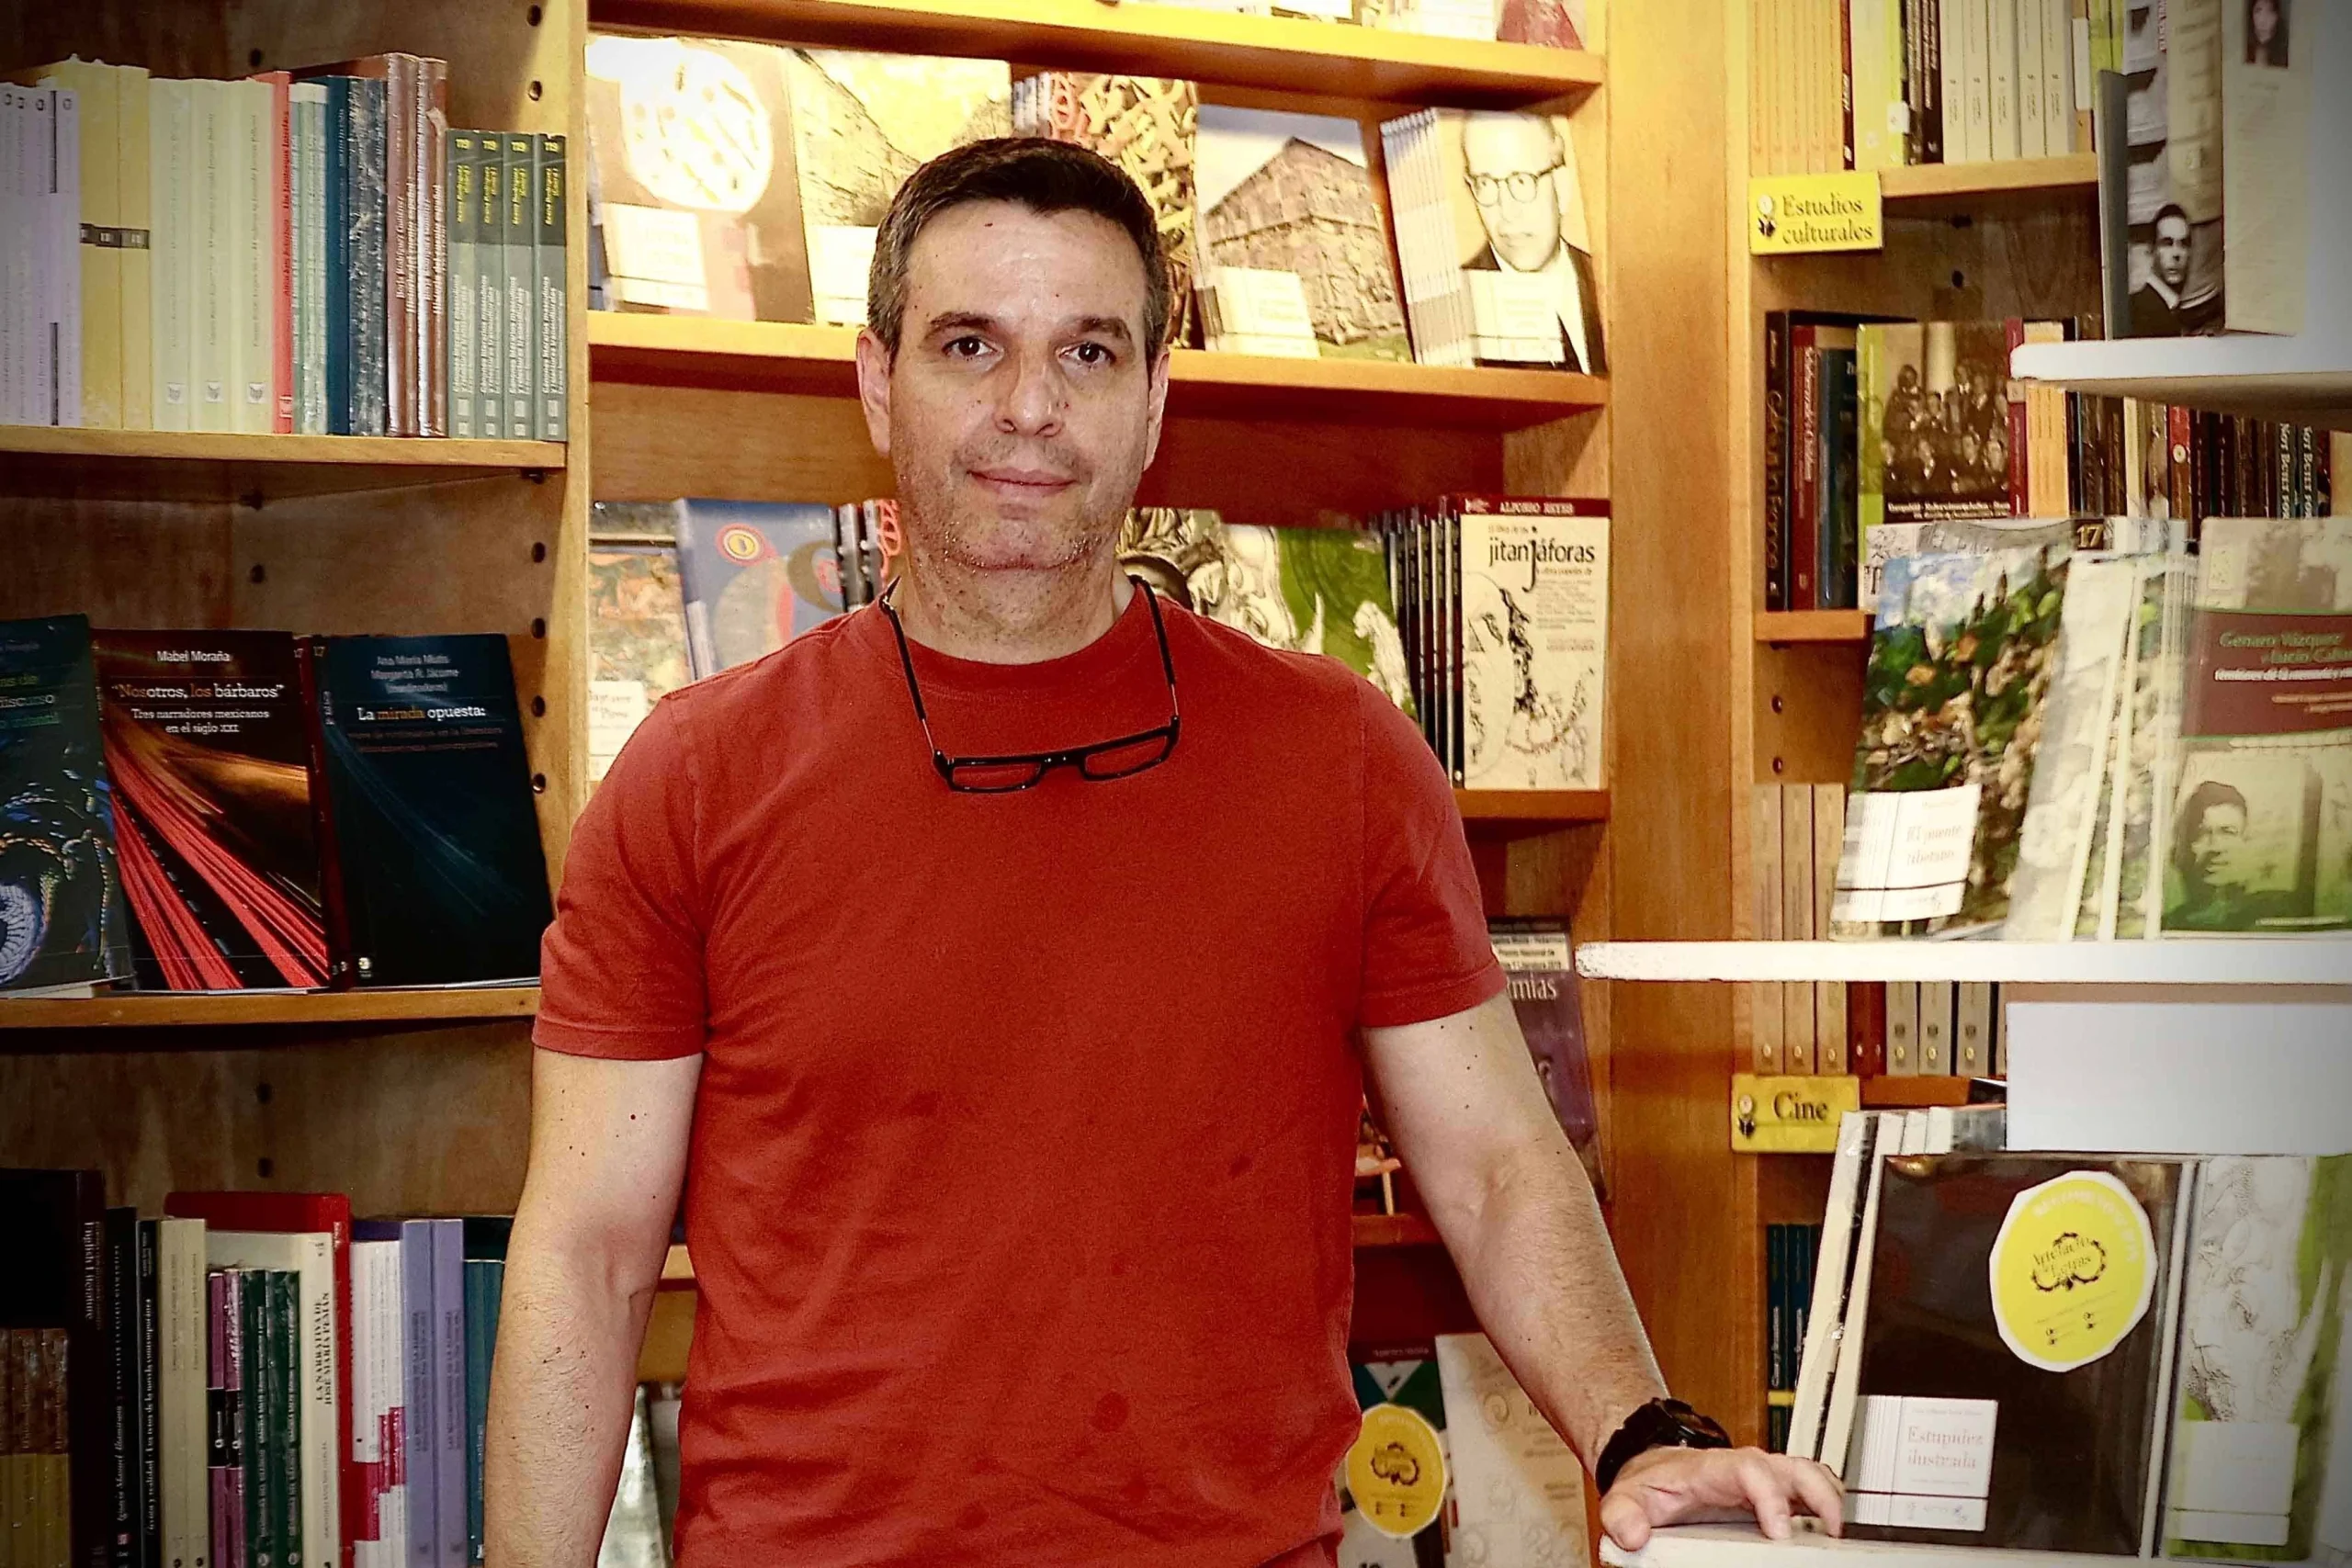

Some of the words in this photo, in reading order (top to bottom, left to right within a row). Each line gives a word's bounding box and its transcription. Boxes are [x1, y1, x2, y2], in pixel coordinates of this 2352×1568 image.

[1782, 191, 1863, 217] Estudios
[1782, 218, 1873, 244] culturales
[2077, 525, 2104, 548] 17
[157, 650, 188, 662] Mabel
[191, 649, 232, 662] Moraña
[191, 682, 213, 699] los
[131, 708, 153, 719] Tres
[157, 707, 212, 719] narradores
[215, 707, 269, 719] mexicanos
[356, 706, 375, 721] La
[377, 704, 424, 720] mirada
[427, 705, 486, 722] opuesta:
[166, 724, 179, 733] en
[181, 722, 190, 733] el
[193, 722, 218, 735] siglo
[1773, 1090, 1827, 1122] Cine
[313, 1315, 323, 1383] NARRATIVA
[322, 1336, 333, 1376] MARÍA
[322, 1380, 333, 1405] JOSÉ
[1908, 1426, 1984, 1449] Estupidez
[1908, 1449, 1976, 1470] ilustrada
